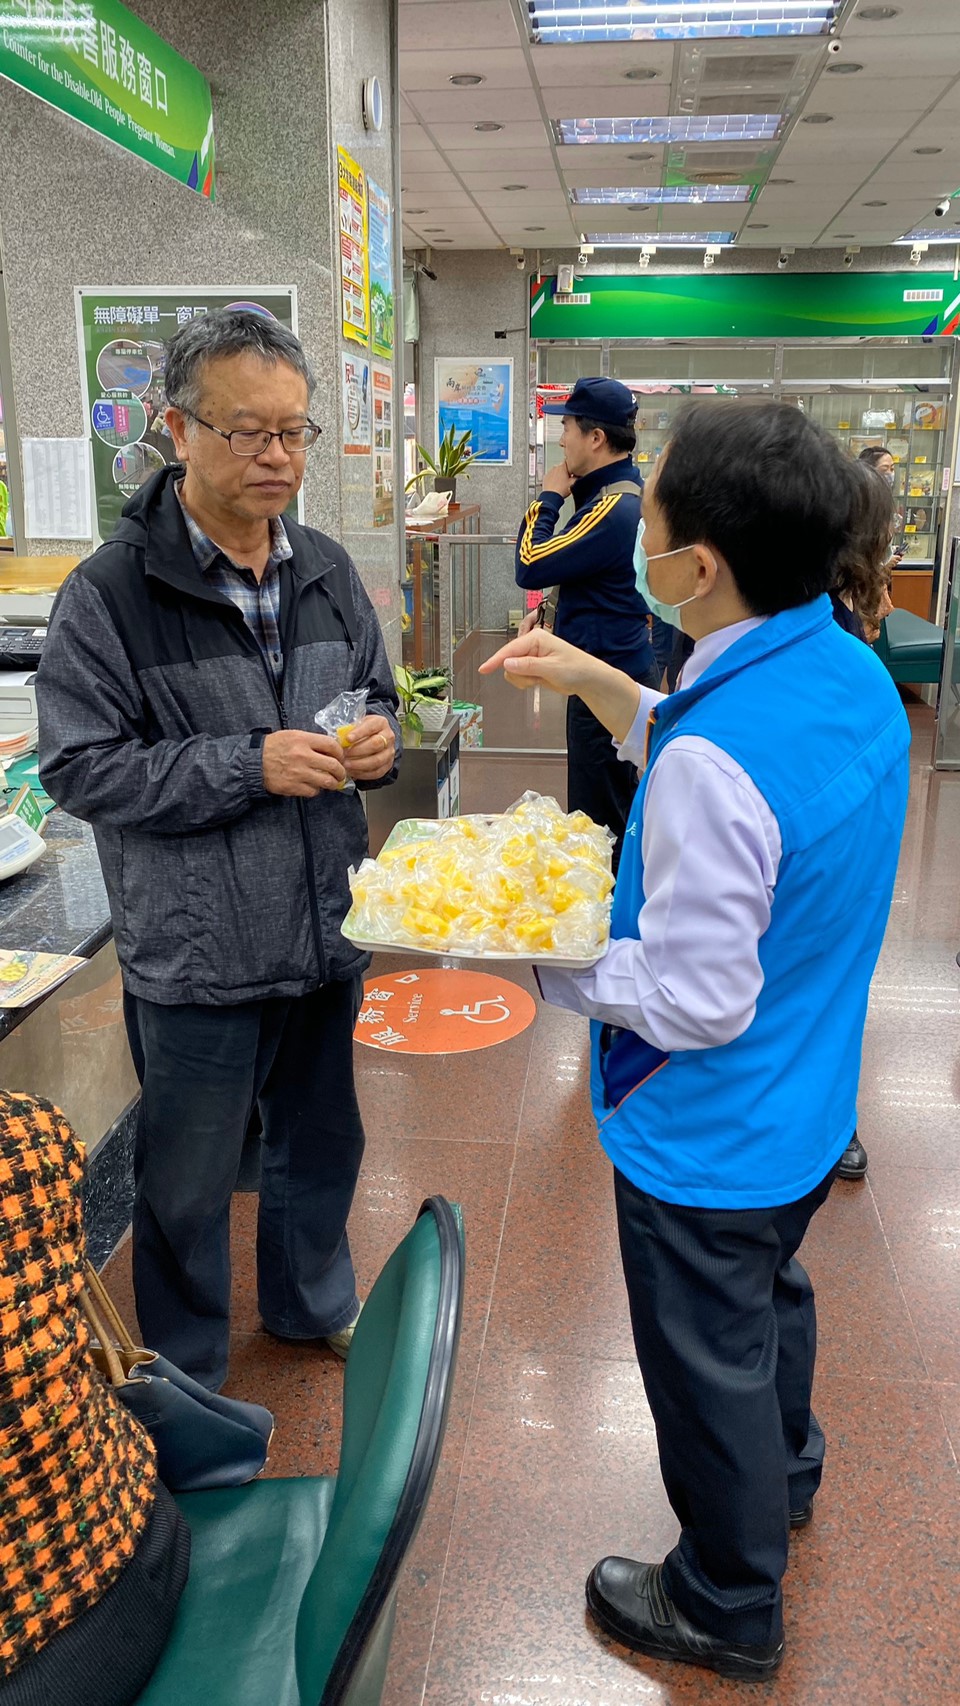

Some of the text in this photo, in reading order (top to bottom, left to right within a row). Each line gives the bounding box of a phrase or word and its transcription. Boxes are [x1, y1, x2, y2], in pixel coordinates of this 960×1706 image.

[3, 28, 37, 67] Counter
[37, 51, 50, 75] for
[50, 62, 63, 84] the
[104, 97, 126, 127] People
[402, 993, 423, 1023] Service
